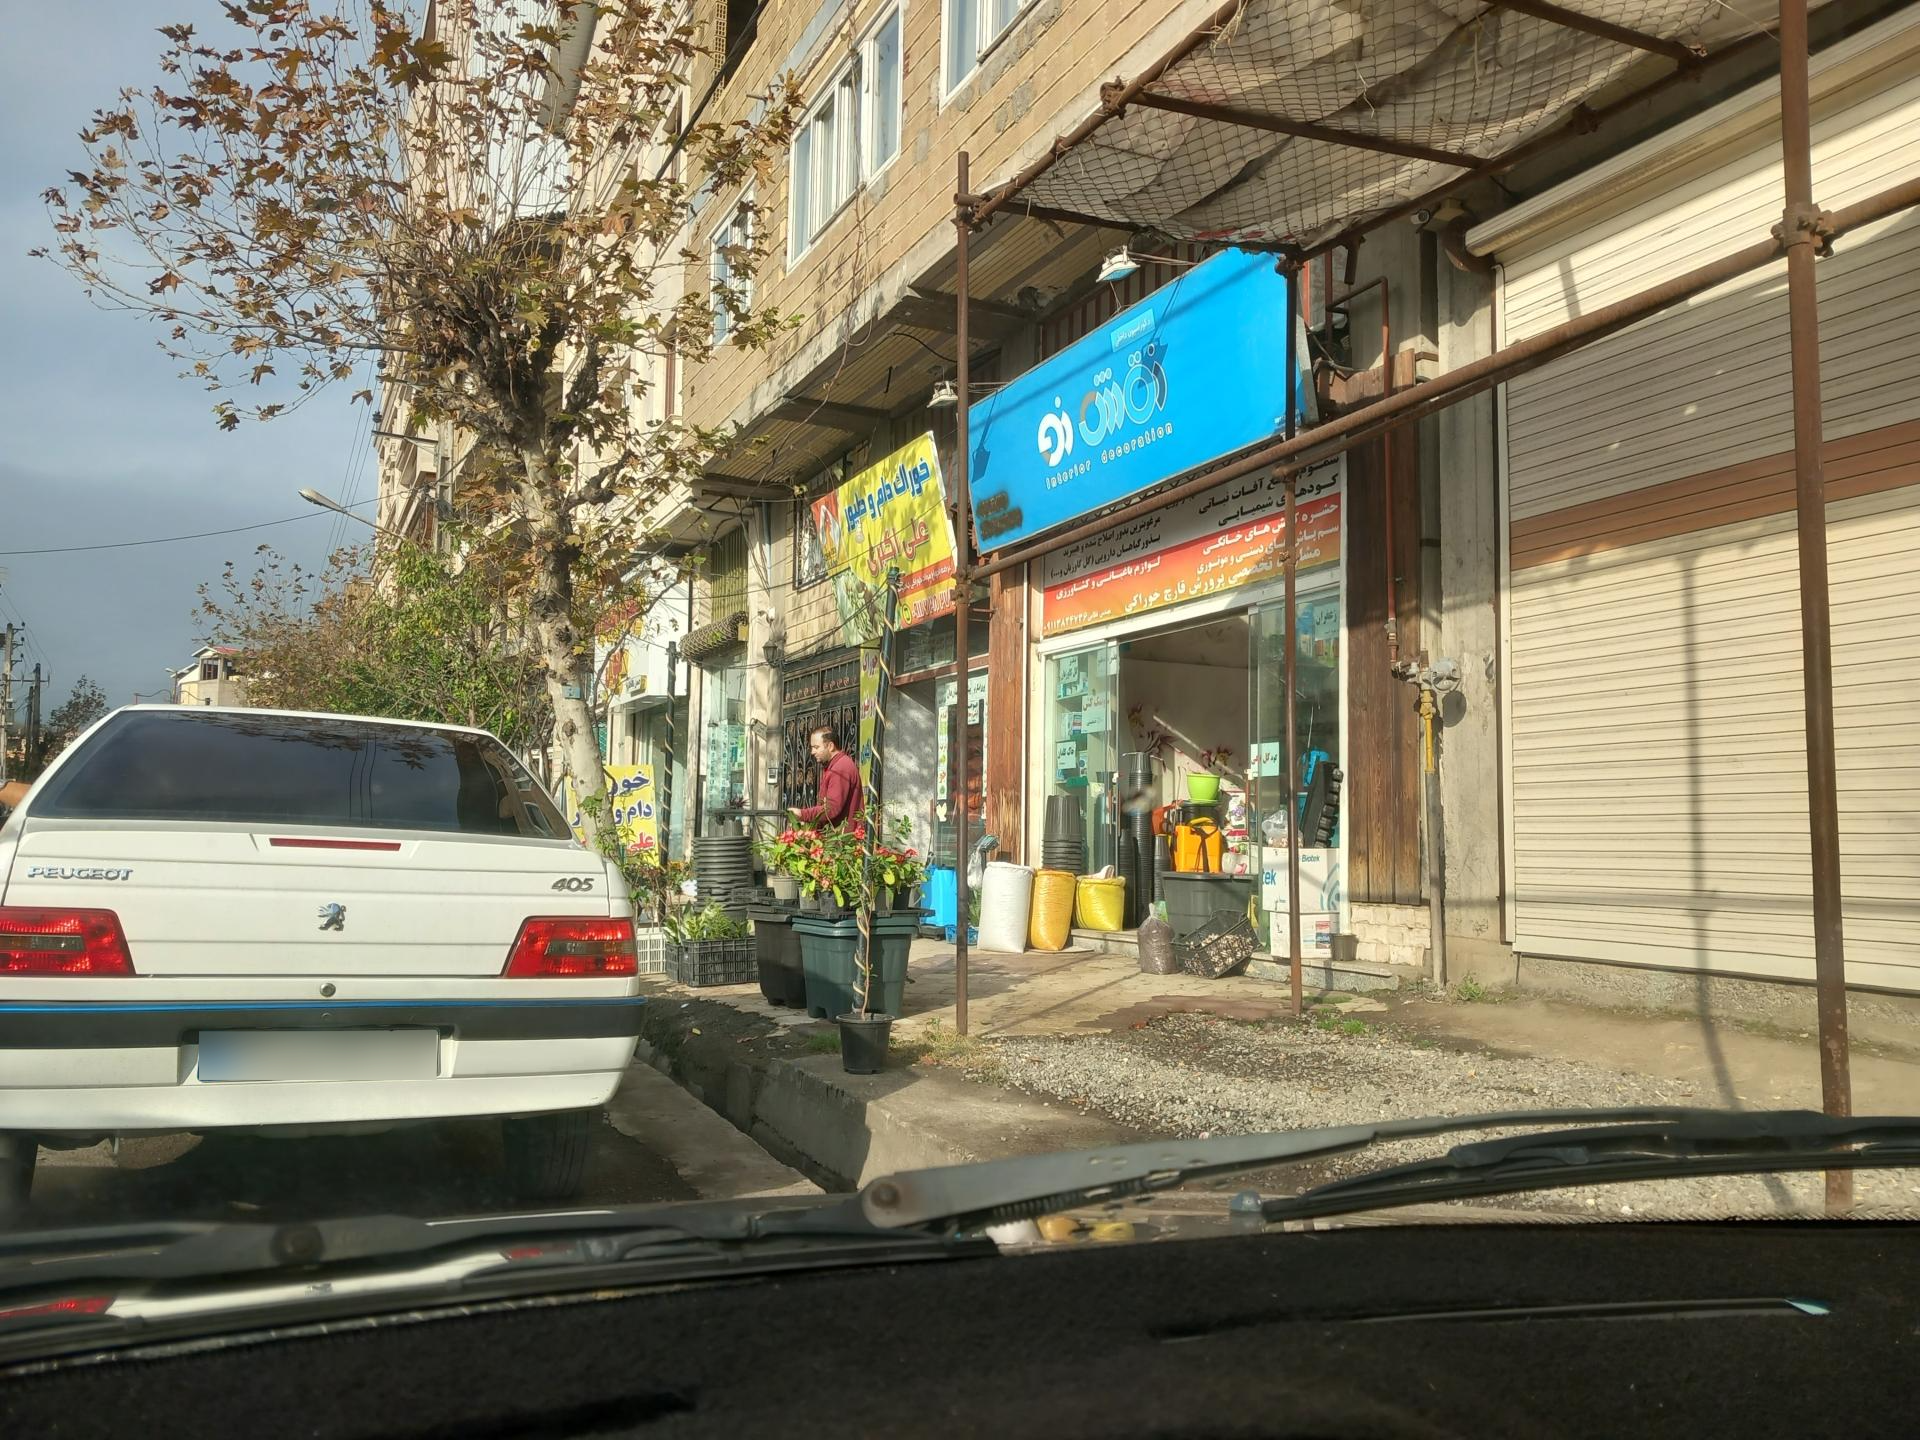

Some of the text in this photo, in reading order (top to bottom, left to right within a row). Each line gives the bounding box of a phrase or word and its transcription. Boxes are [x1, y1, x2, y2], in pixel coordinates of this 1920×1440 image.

[1045, 423, 1173, 490] interior decoration
[845, 457, 931, 532] خوراک دام و طیور
[1231, 478, 1264, 501] آفات
[1275, 473, 1340, 509] کودهی
[1198, 493, 1230, 515] نباتی
[1218, 497, 1274, 528] شیمیایی
[1301, 502, 1339, 525] حشره
[1202, 531, 1243, 556] خانگی
[1244, 523, 1271, 544] های
[1228, 554, 1236, 567] و
[1235, 544, 1264, 564] دستی
[1055, 555, 1162, 600] لوازم باغبانی و کشاورزی
[1228, 558, 1273, 585] تخصصی
[1163, 580, 1187, 603] قارچ
[1188, 574, 1225, 596] پرورش
[1123, 590, 1161, 614] خوراکی
[614, 800, 653, 825] دام و
[26, 864, 134, 882] PEUGEOT
[550, 877, 595, 893] 405
